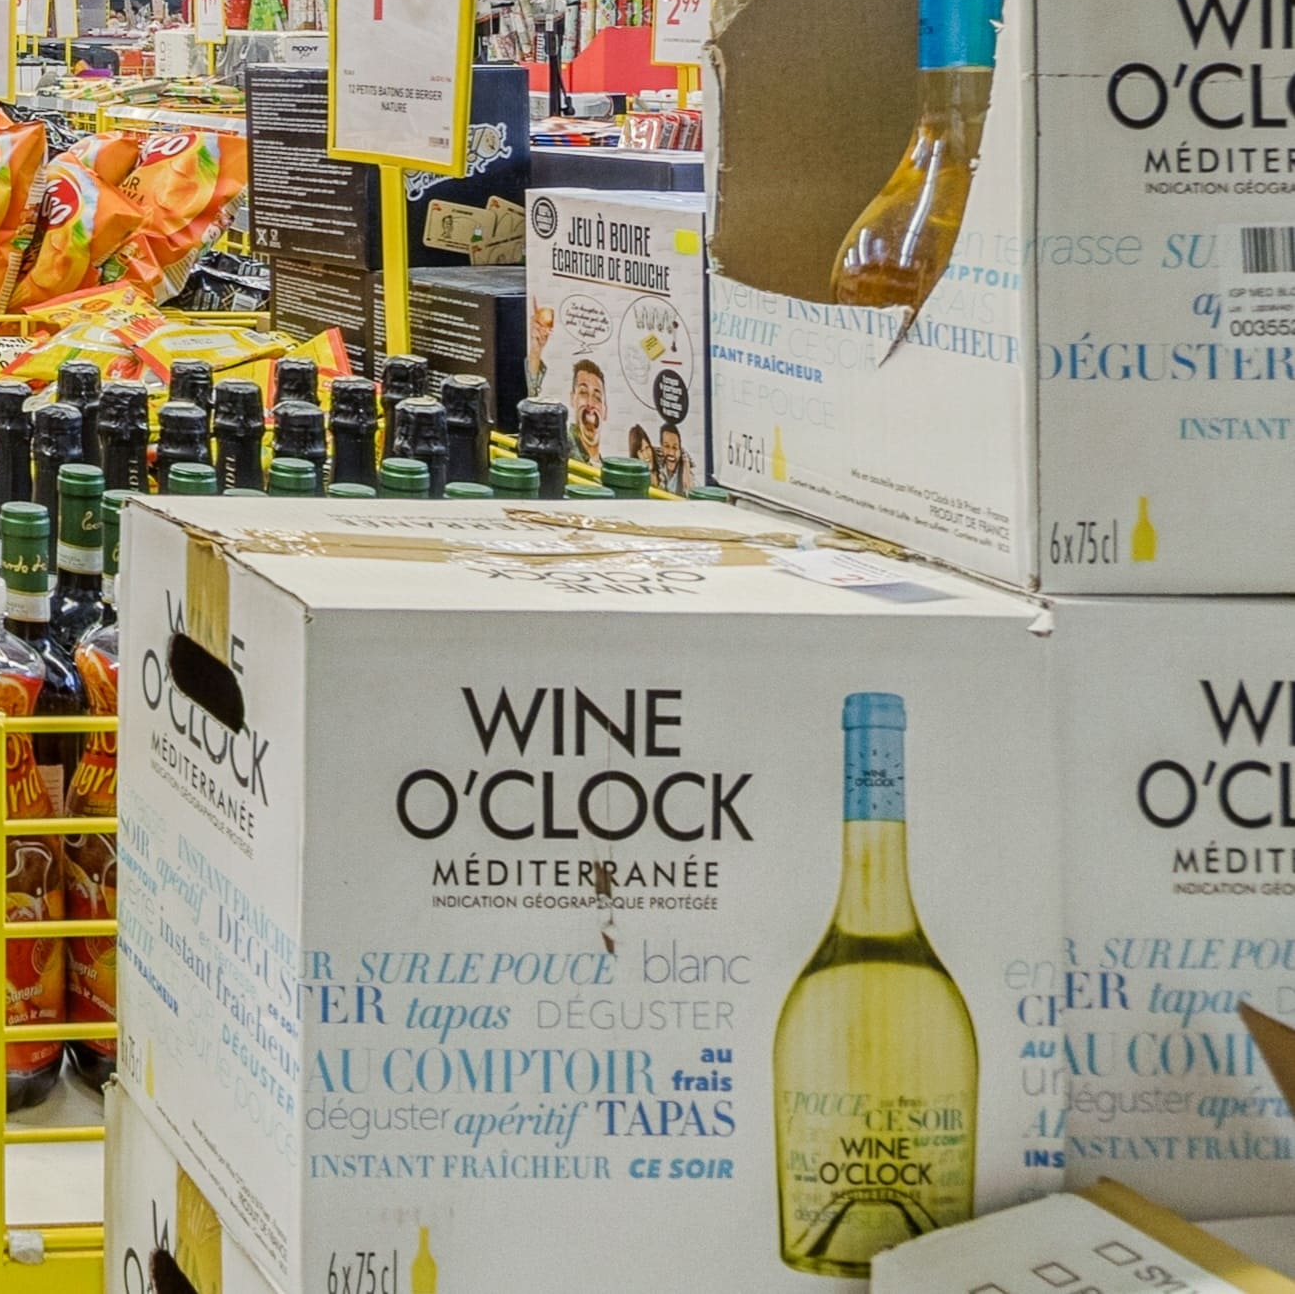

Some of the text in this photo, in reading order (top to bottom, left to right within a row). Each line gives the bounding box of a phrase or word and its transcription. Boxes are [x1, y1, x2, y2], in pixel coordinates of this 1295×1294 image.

[356, 84, 377, 98] PETITS
[414, 89, 443, 102] BERGER
[381, 101, 408, 114] NATURE
[1107, 62, 1295, 130] O'CL
[1146, 182, 1229, 195] INDICATION
[568, 213, 651, 257] JEU À BOIRE
[552, 242, 671, 291] ÉCARTEUR DE BOUCHE
[1179, 417, 1291, 441] INSTANT
[461, 686, 682, 758] WINE
[396, 769, 754, 842] O'CLOCK
[432, 852, 719, 889] MÉDITERRANÉE
[1172, 840, 1295, 874] MÉDIT
[432, 893, 718, 911] INDICATION GÉOGRAPQUE PROTÉGÉE
[356, 951, 440, 985] SUR
[438, 951, 484, 985] LE
[491, 951, 619, 986] POUCE
[643, 939, 752, 985] blanc
[405, 986, 735, 1045] tapas DÉGUSTER
[700, 1047, 733, 1064] au
[306, 1047, 658, 1096] AU COMPTOIR
[671, 1069, 733, 1092] frais
[305, 1097, 737, 1149] déguster apéritif TAPAS
[908, 1108, 964, 1132] SOIR
[310, 1148, 735, 1179] INSTANT FRAÎCHEUR CE SOIR
[840, 1136, 911, 1161] WINE
[1066, 1135, 1181, 1161] NSTANT
[818, 1162, 933, 1187] O'CLOCK
